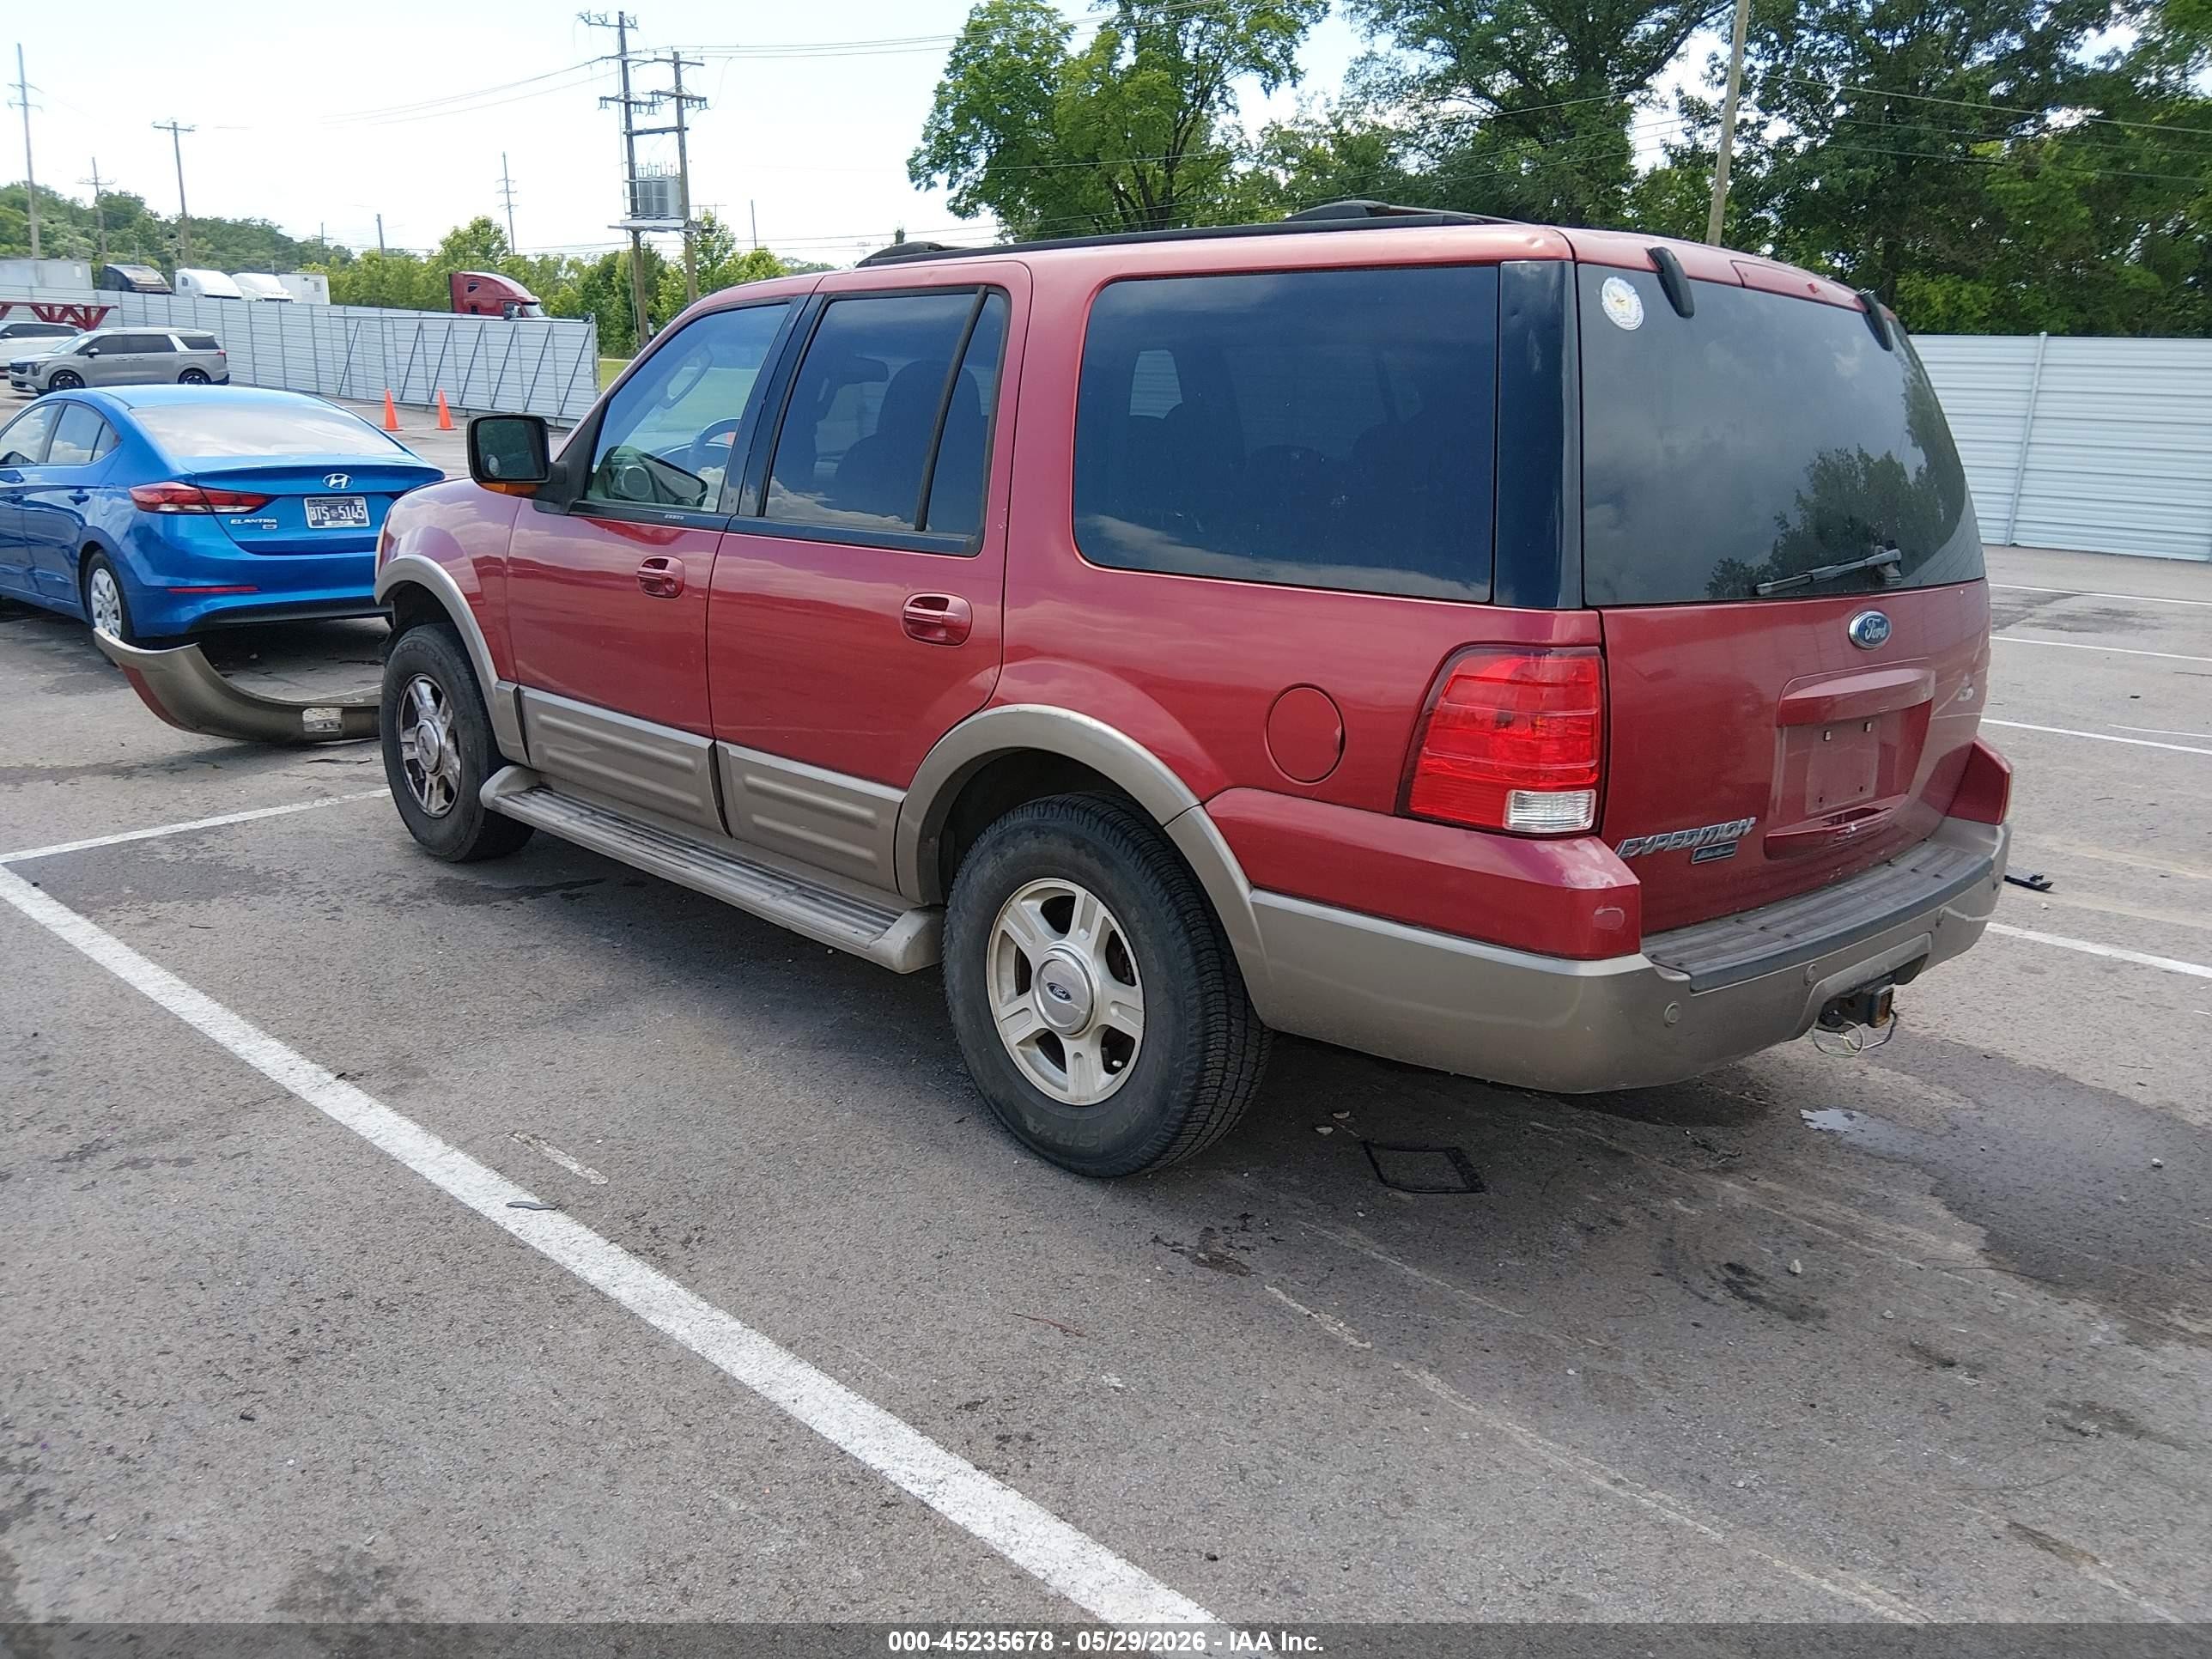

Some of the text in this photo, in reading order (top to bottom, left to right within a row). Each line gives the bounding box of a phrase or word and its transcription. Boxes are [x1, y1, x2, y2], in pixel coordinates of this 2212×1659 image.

[308, 505, 365, 520] BTS 5145
[1614, 817, 1757, 859] EXPEDITION
